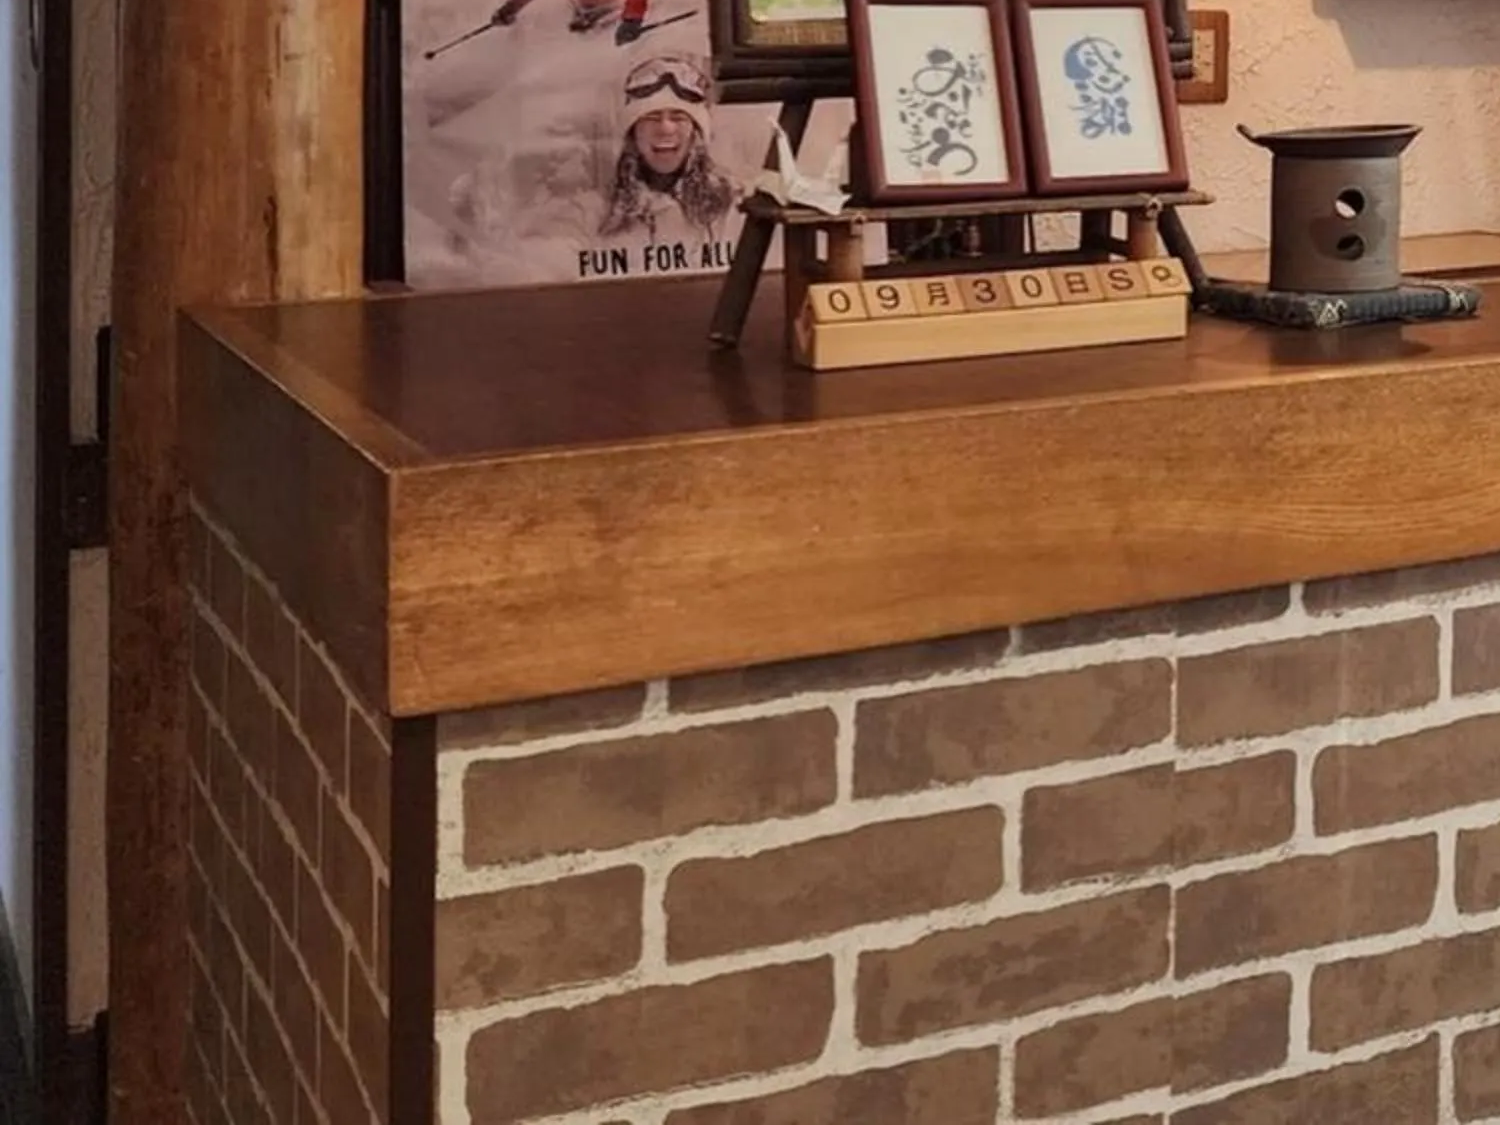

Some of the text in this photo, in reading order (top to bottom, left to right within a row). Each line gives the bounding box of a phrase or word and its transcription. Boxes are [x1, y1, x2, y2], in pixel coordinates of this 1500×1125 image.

[579, 240, 735, 276] FUN FOR ALL
